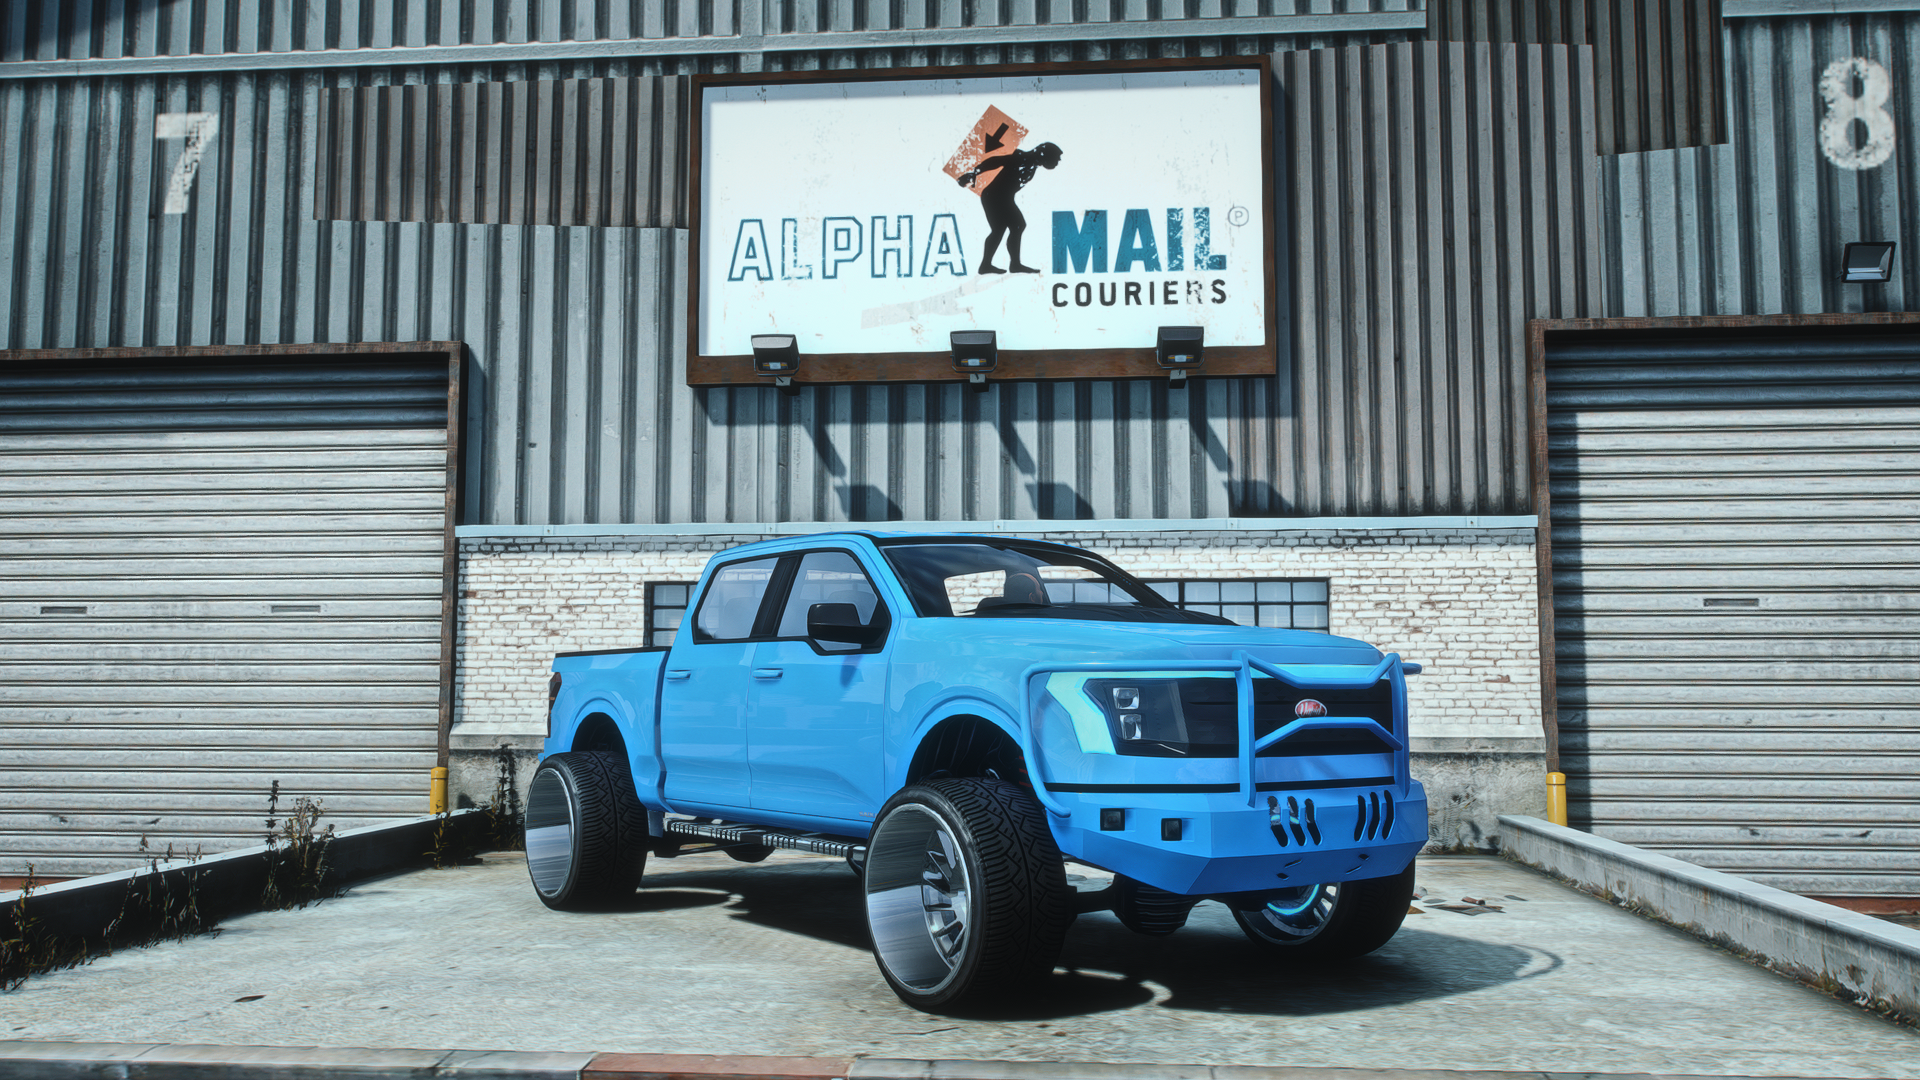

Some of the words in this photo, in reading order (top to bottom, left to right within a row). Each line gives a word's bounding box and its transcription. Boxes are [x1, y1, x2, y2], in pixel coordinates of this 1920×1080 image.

[1819, 57, 1895, 170] 8
[156, 112, 219, 214] 7
[728, 214, 968, 282] ALPHA
[1052, 207, 1227, 274] MAIL
[1052, 279, 1227, 307] COURIERS
